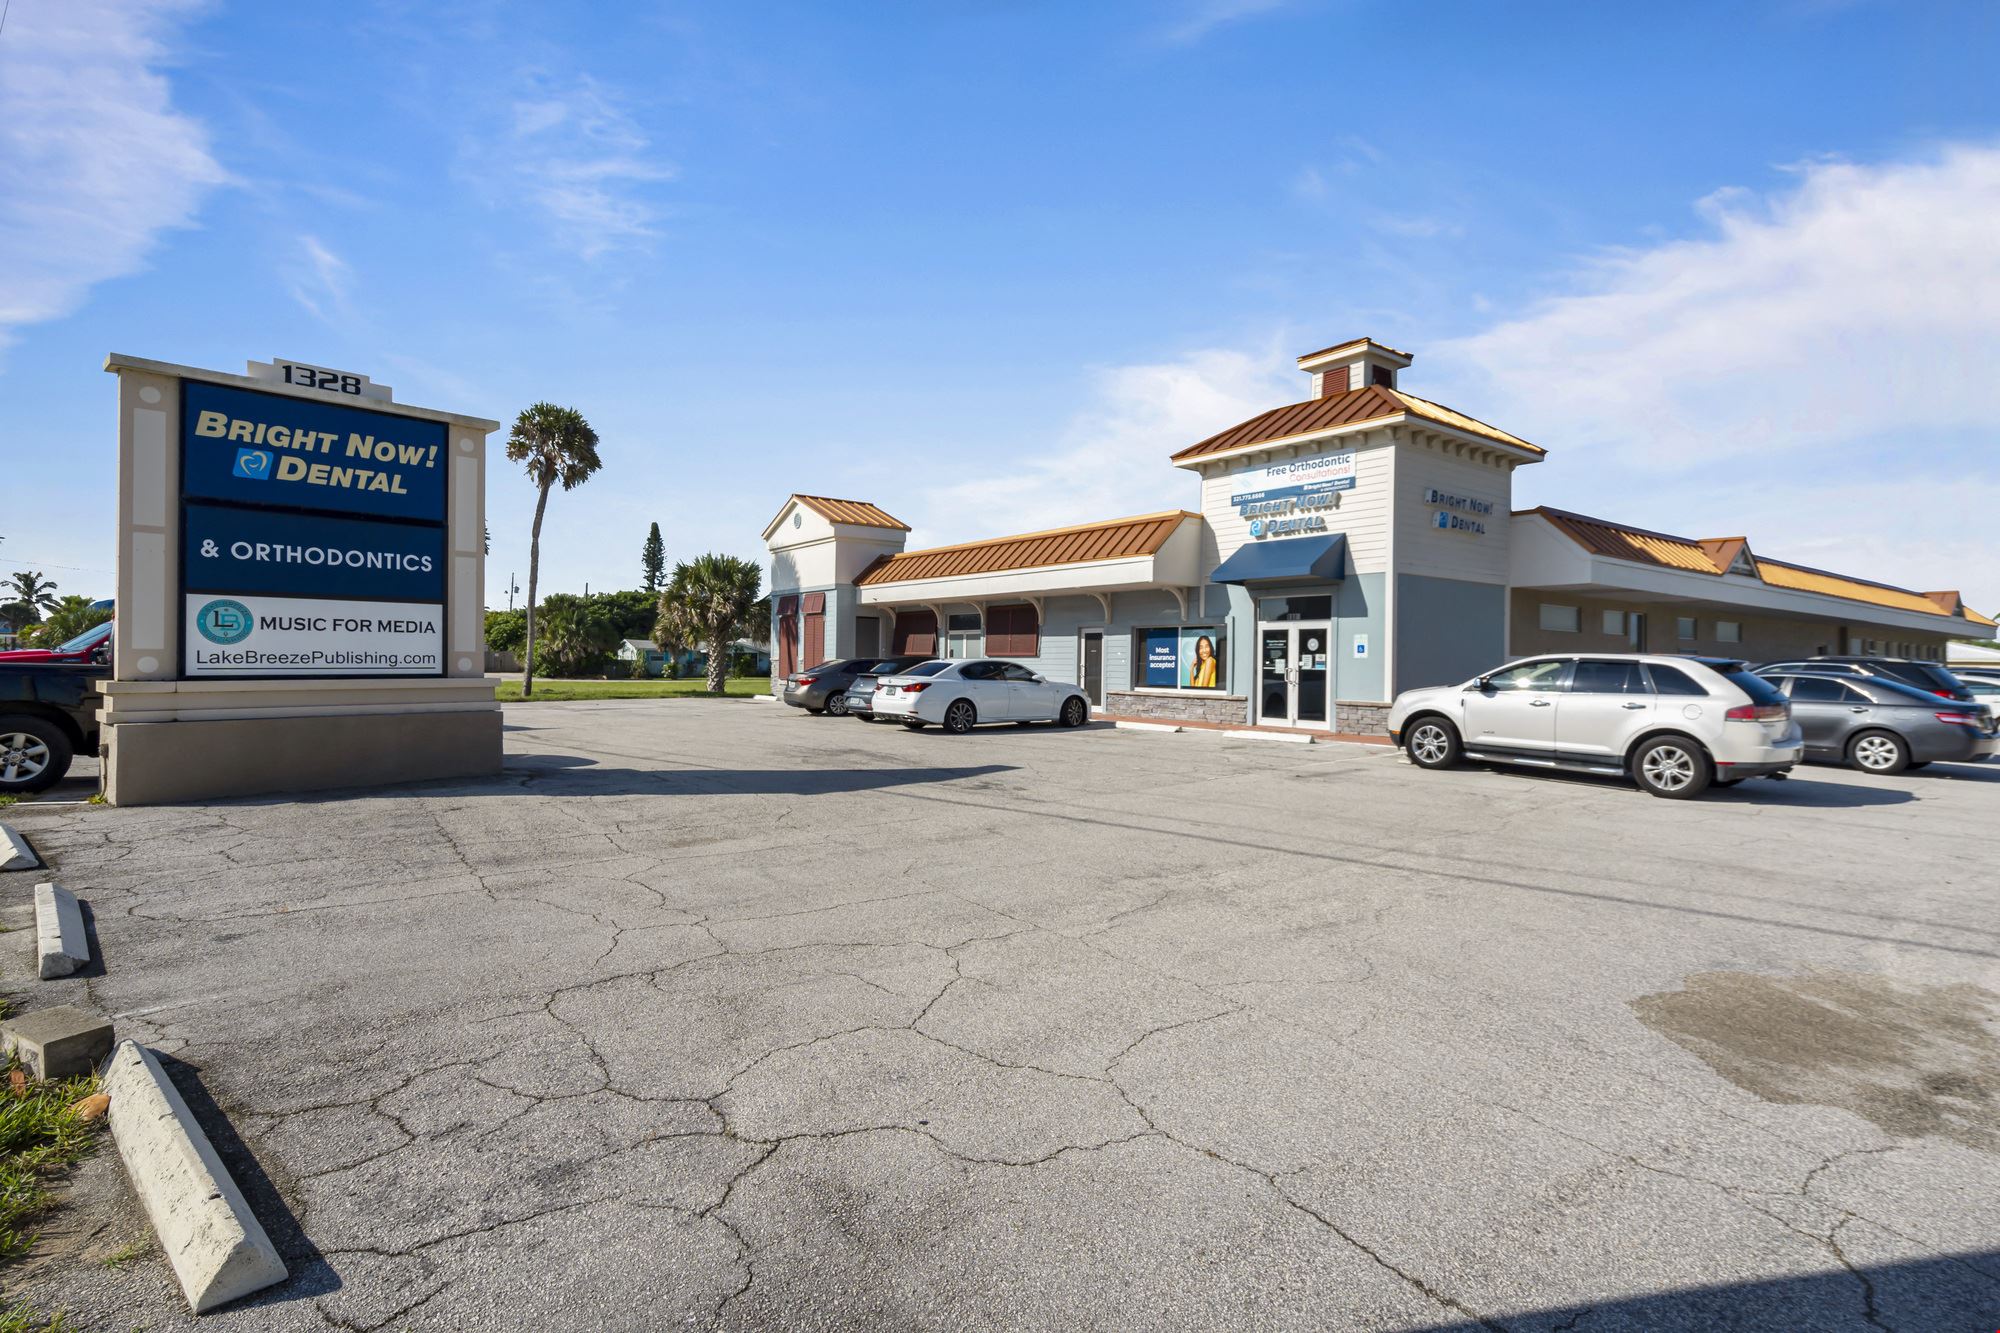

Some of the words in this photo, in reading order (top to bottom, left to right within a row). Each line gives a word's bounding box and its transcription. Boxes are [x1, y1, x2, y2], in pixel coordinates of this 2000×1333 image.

[281, 364, 361, 395] 1328
[194, 409, 339, 452] BRIGHT
[345, 432, 438, 468] NOW!
[276, 456, 408, 495] DENTAL
[1266, 466, 1287, 477] Free
[1289, 454, 1351, 473] Orthodontic
[1239, 499, 1291, 517] BRIGHT
[1431, 490, 1467, 509] BRIGHT
[1469, 499, 1493, 515] NOW!
[1267, 516, 1323, 533] DENTAL
[1451, 515, 1486, 534] DENTAL
[200, 539, 219, 558] &
[230, 541, 433, 572] ORTHODONTICS
[259, 615, 327, 632] MUSIC
[332, 617, 373, 632] FOR
[377, 618, 436, 634] MEDIA
[196, 649, 436, 668] LakeBreezePublishing.com
[1149, 661, 1175, 669] accepted
